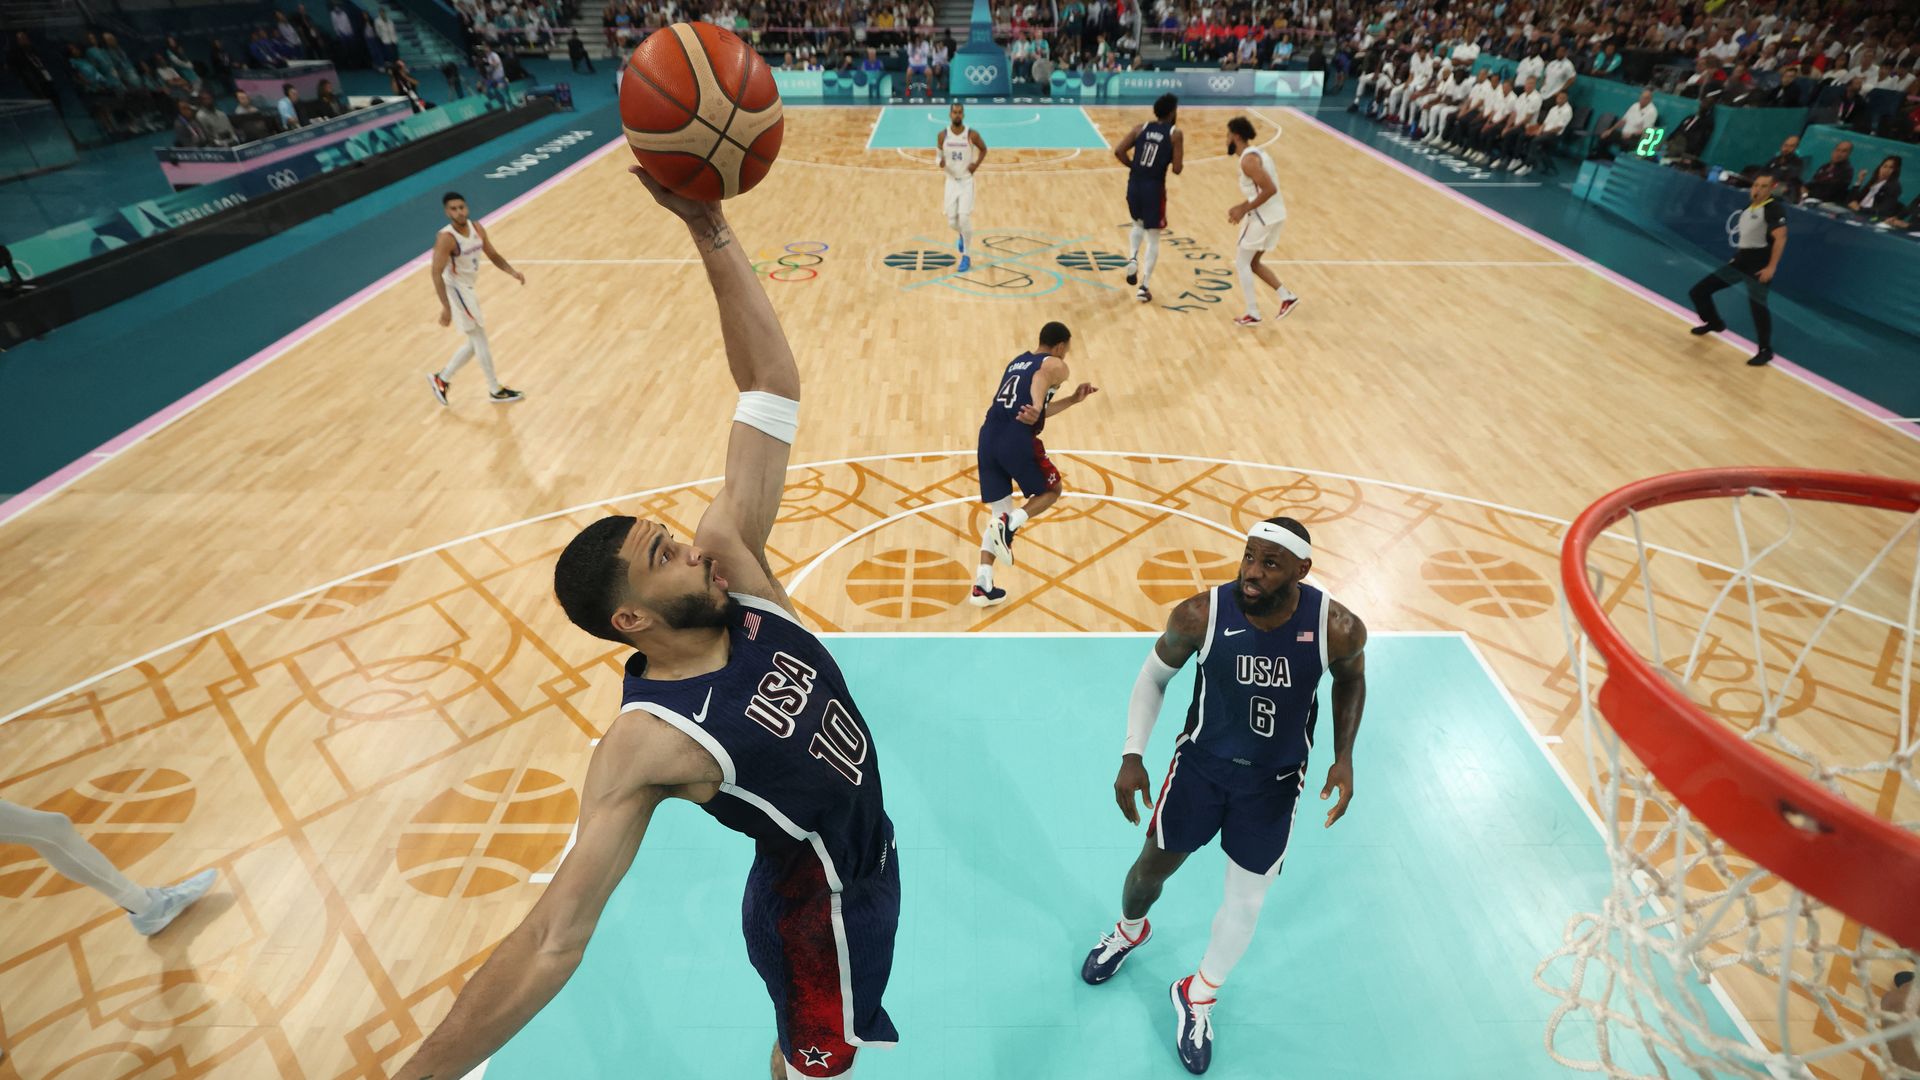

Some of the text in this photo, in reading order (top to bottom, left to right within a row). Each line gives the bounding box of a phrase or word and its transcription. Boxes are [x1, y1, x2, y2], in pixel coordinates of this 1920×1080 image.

[1124, 78, 1182, 88] PARIS 2024
[1636, 127, 1664, 156] 22
[1161, 267, 1233, 313] 2024
[997, 375, 1020, 408] 4
[1236, 655, 1292, 688] USA
[744, 651, 817, 739] USA
[1250, 695, 1276, 738] 6
[808, 698, 868, 786] 10
